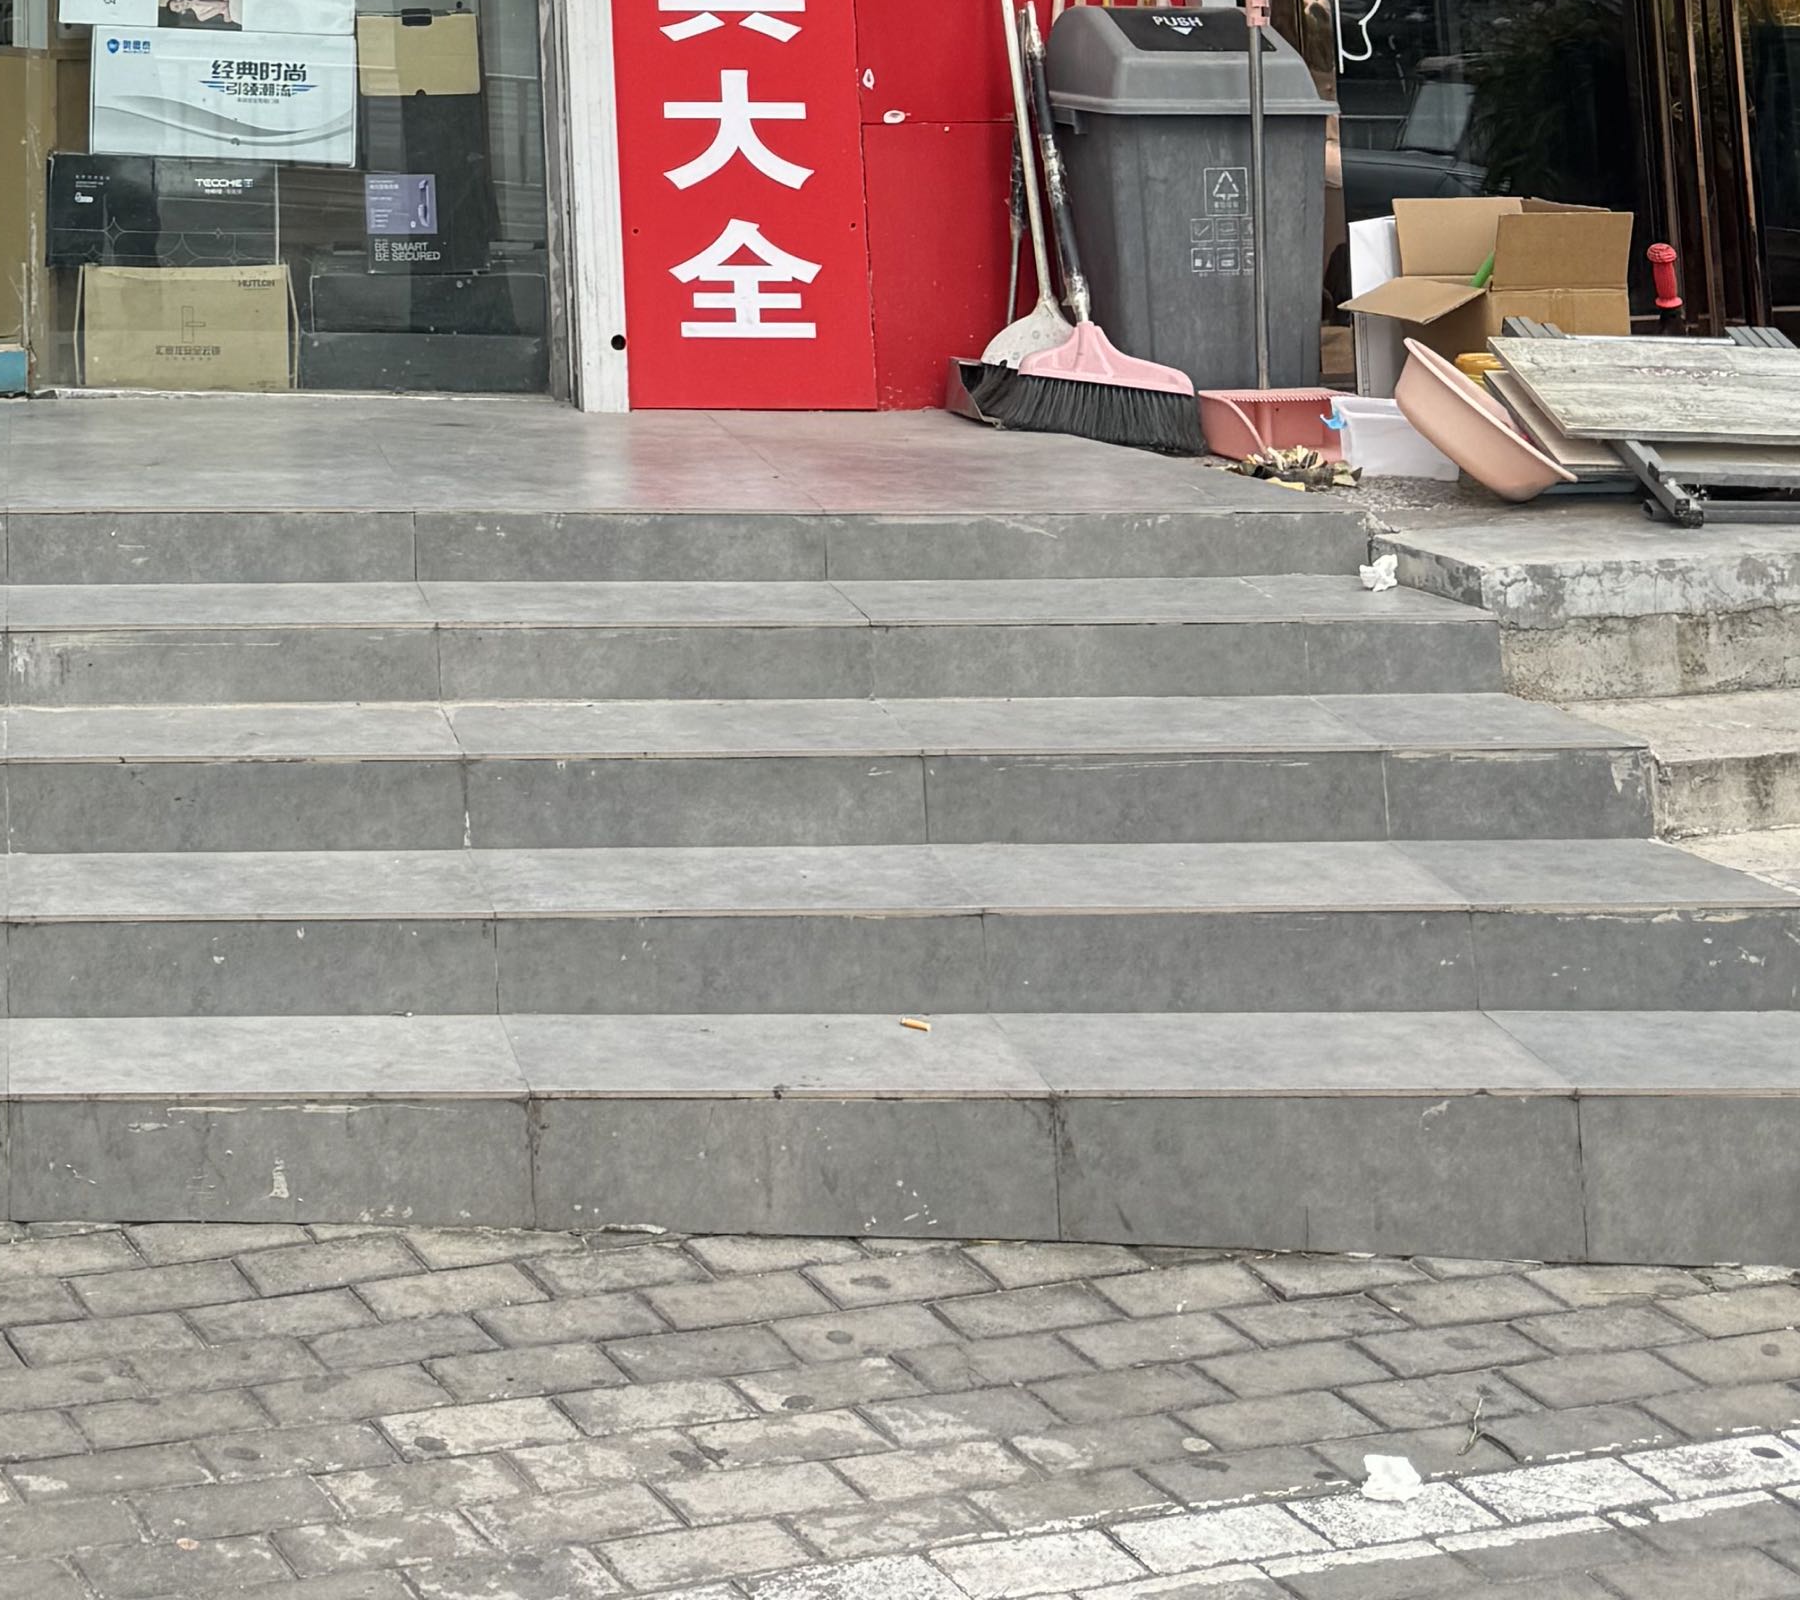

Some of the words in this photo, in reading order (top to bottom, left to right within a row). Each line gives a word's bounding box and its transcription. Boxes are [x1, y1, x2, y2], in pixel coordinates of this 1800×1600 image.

[1152, 15, 1204, 28] PUSH
[211, 59, 307, 82] 经典时尚
[391, 241, 429, 252] SMART
[375, 251, 390, 261] BE
[391, 251, 441, 261] SECURED
